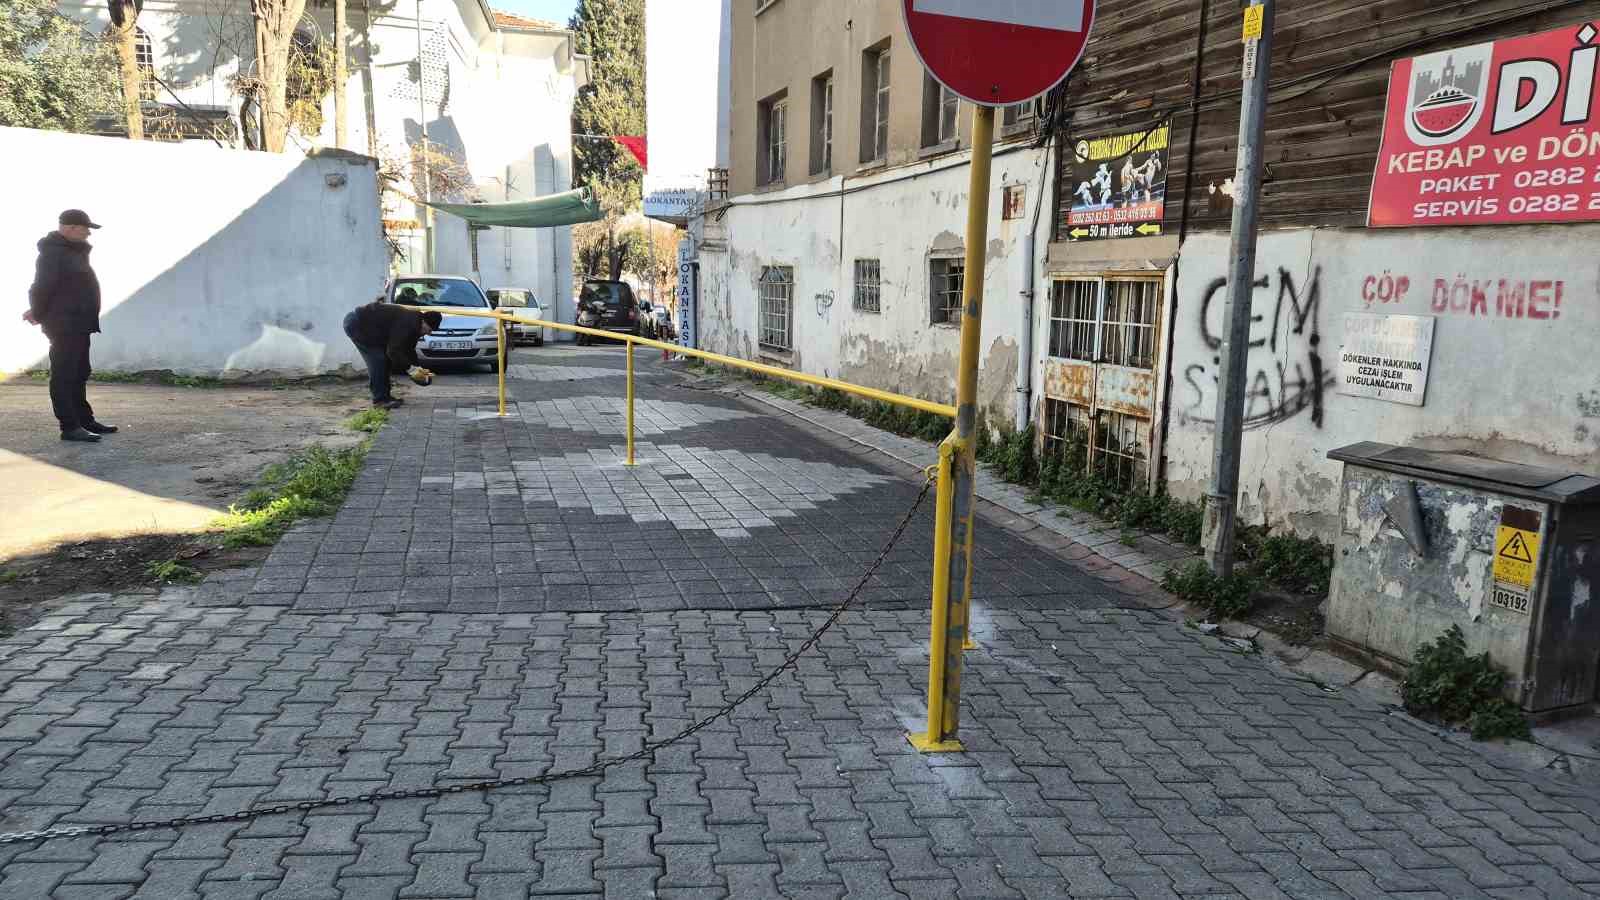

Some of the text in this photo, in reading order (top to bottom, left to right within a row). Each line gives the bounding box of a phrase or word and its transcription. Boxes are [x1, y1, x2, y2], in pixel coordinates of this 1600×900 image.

[1387, 144, 1486, 174] KEBAP
[1493, 145, 1528, 164] ve
[1419, 173, 1501, 194] PAKET
[1514, 166, 1586, 188] 0282
[1413, 196, 1499, 218] SERVİS
[1508, 193, 1580, 214] 0282
[1089, 224, 1099, 237] 50
[1100, 227, 1108, 236] m
[1361, 269, 1410, 309] ÇÖP
[1343, 353, 1422, 371] DÖKENLER HAKKINDA
[1346, 376, 1413, 392] UYGULANACAKTIR
[1492, 590, 1528, 611] 103192
